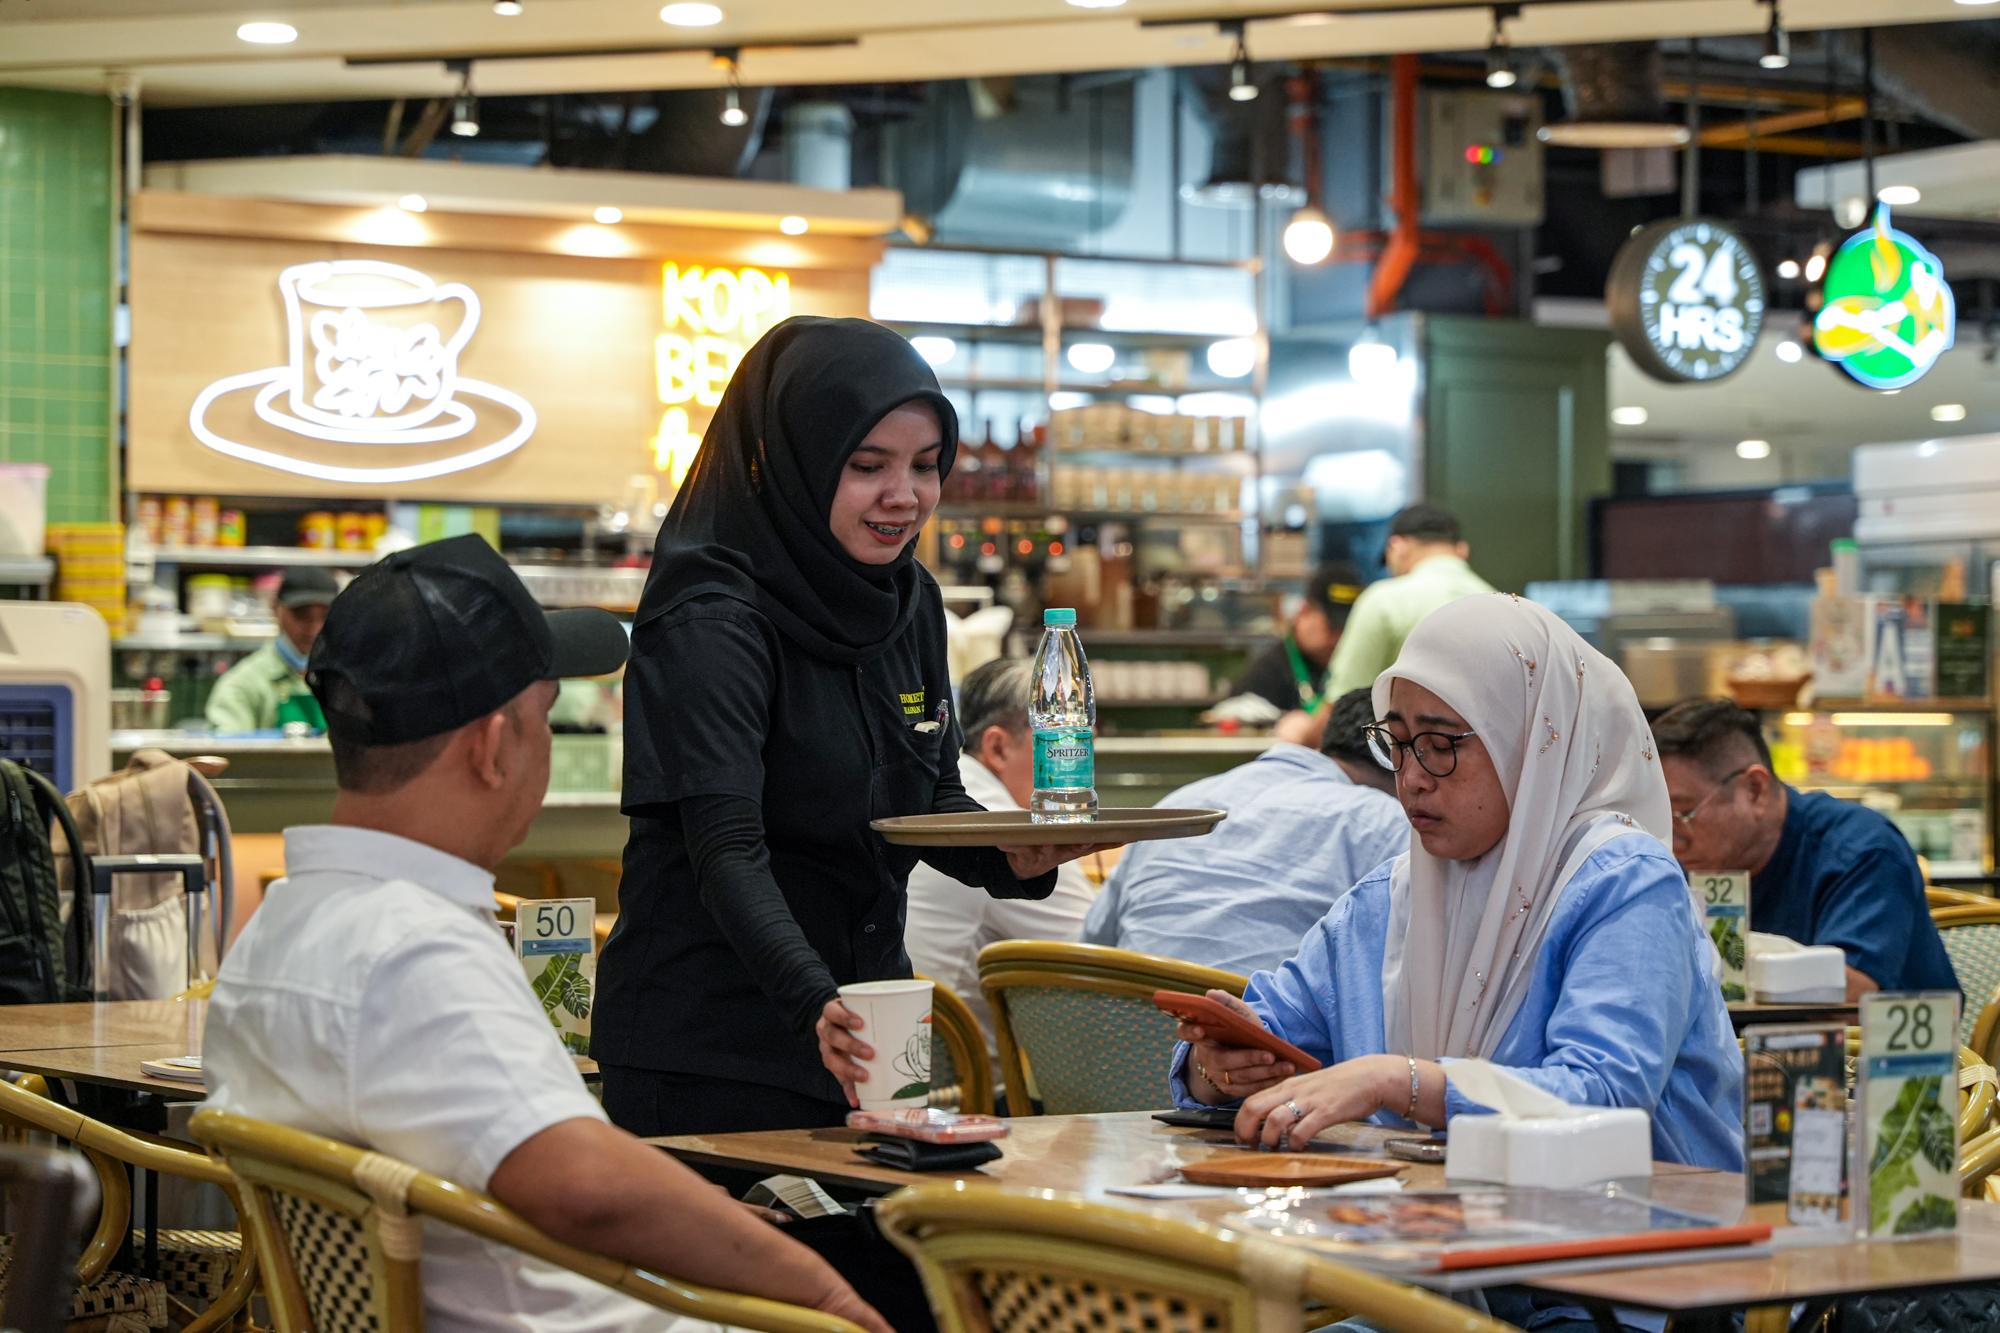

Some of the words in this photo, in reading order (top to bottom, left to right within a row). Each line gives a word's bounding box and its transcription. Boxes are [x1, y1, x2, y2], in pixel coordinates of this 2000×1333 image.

[1667, 243, 1739, 302] 24
[662, 261, 790, 336] KOPI
[1659, 301, 1745, 353] HRS
[655, 333, 743, 406] BE
[1046, 746, 1089, 759] SPRITZER
[1704, 877, 1732, 903] 32
[536, 905, 574, 938] 50
[1887, 1003, 1933, 1051] 28
